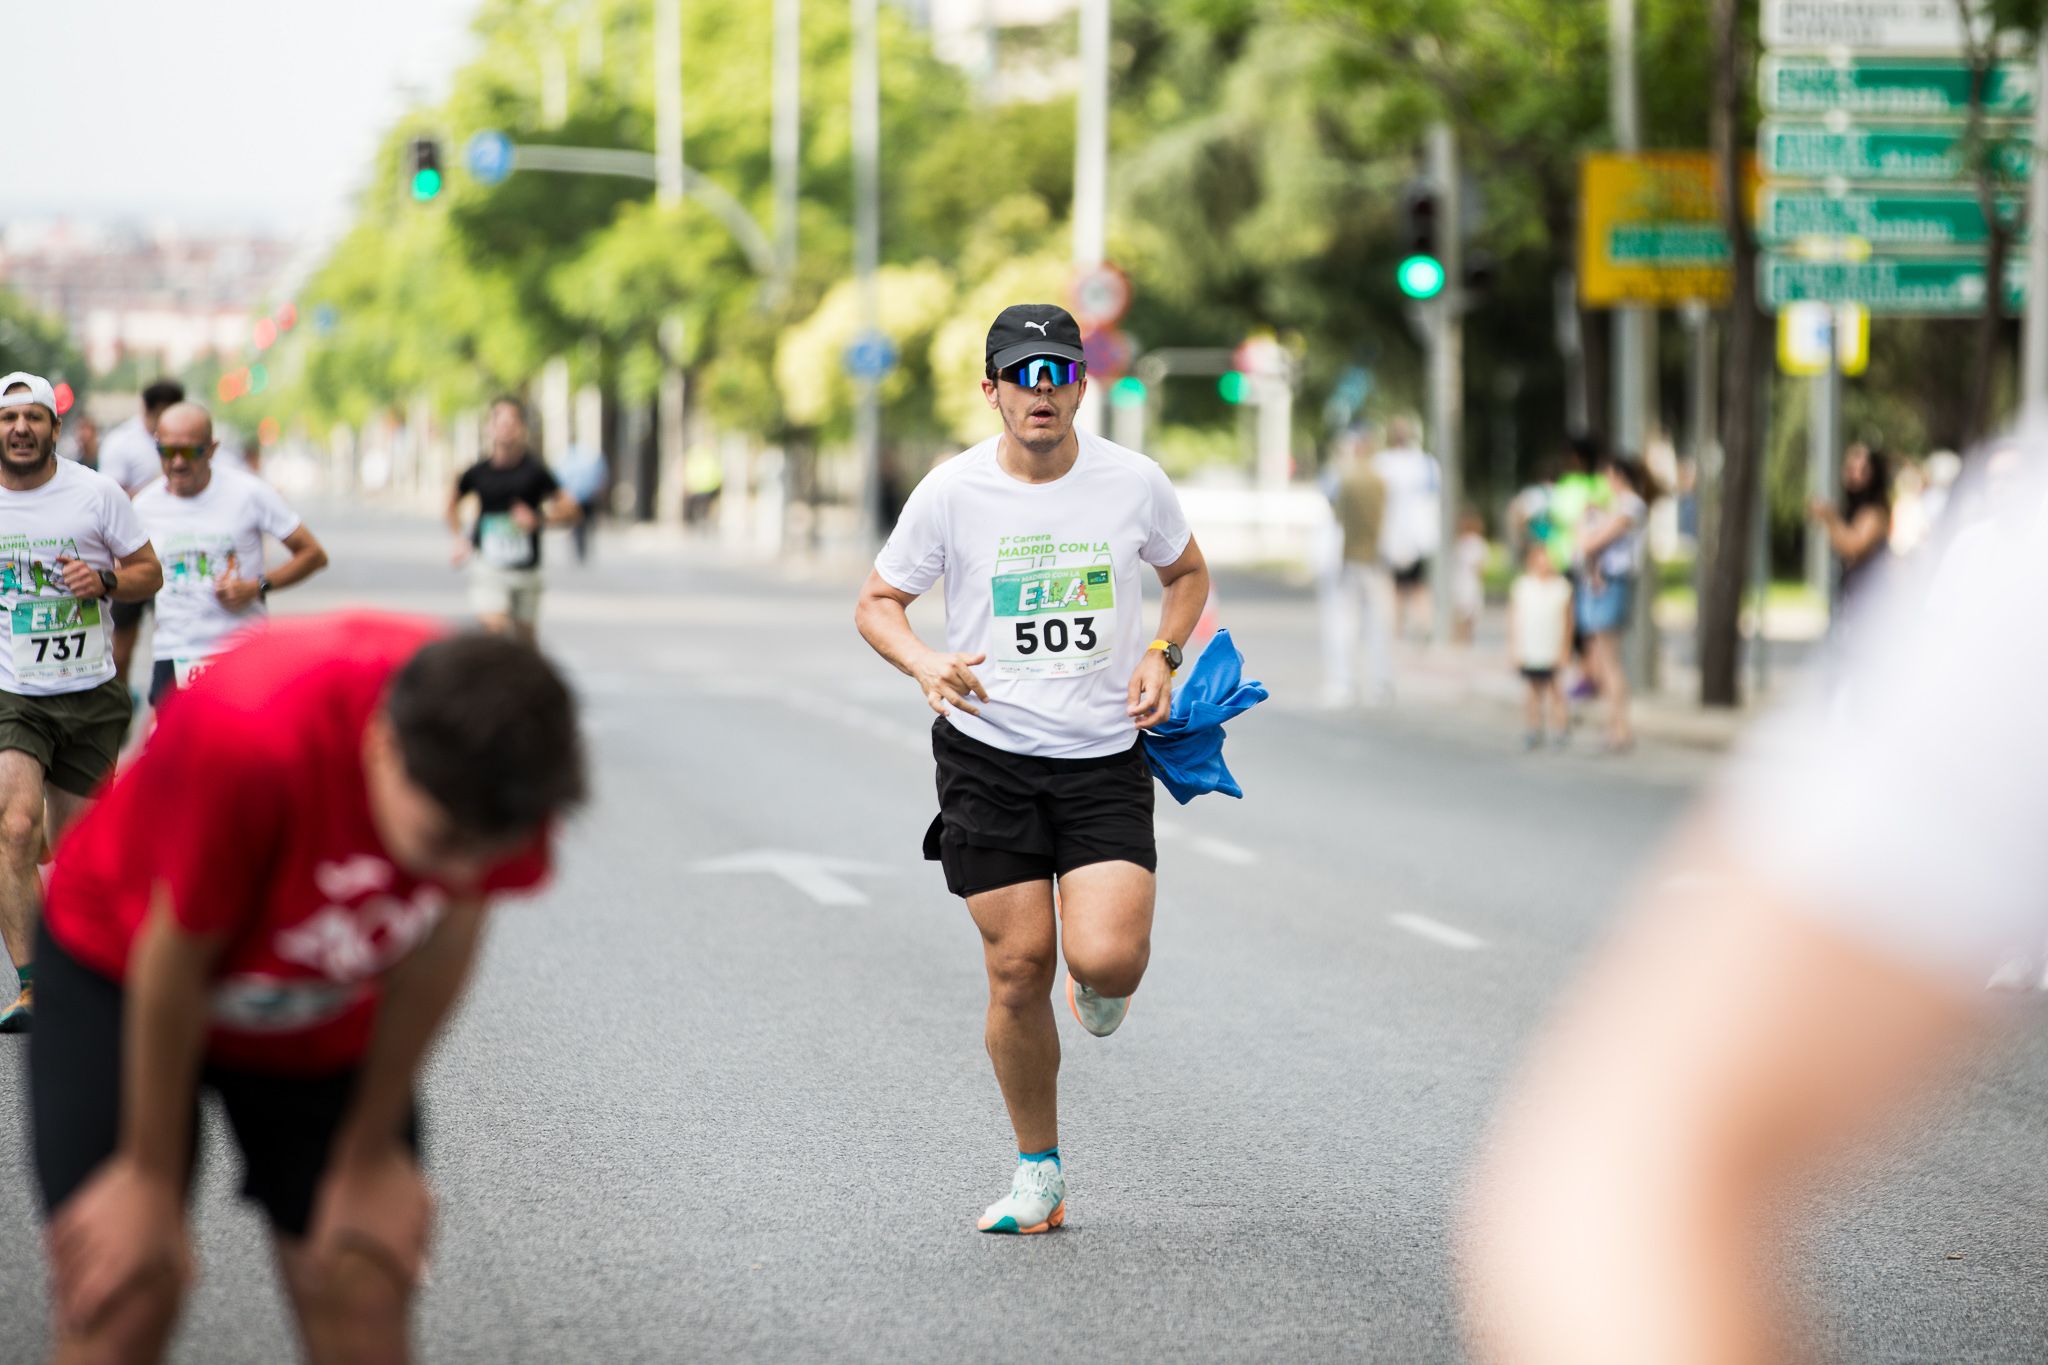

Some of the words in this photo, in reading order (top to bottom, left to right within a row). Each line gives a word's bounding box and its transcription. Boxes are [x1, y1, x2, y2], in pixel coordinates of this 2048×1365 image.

[33, 538, 57, 547] CON
[61, 537, 75, 546] LA
[998, 544, 1055, 558] MADRID
[1059, 543, 1089, 553] CON
[1093, 541, 1110, 552] LA
[1013, 533, 1052, 544] Carrera
[1018, 577, 1089, 612] ELA
[31, 605, 83, 632] ELA
[31, 632, 87, 664] 737
[1016, 617, 1097, 655] 503
